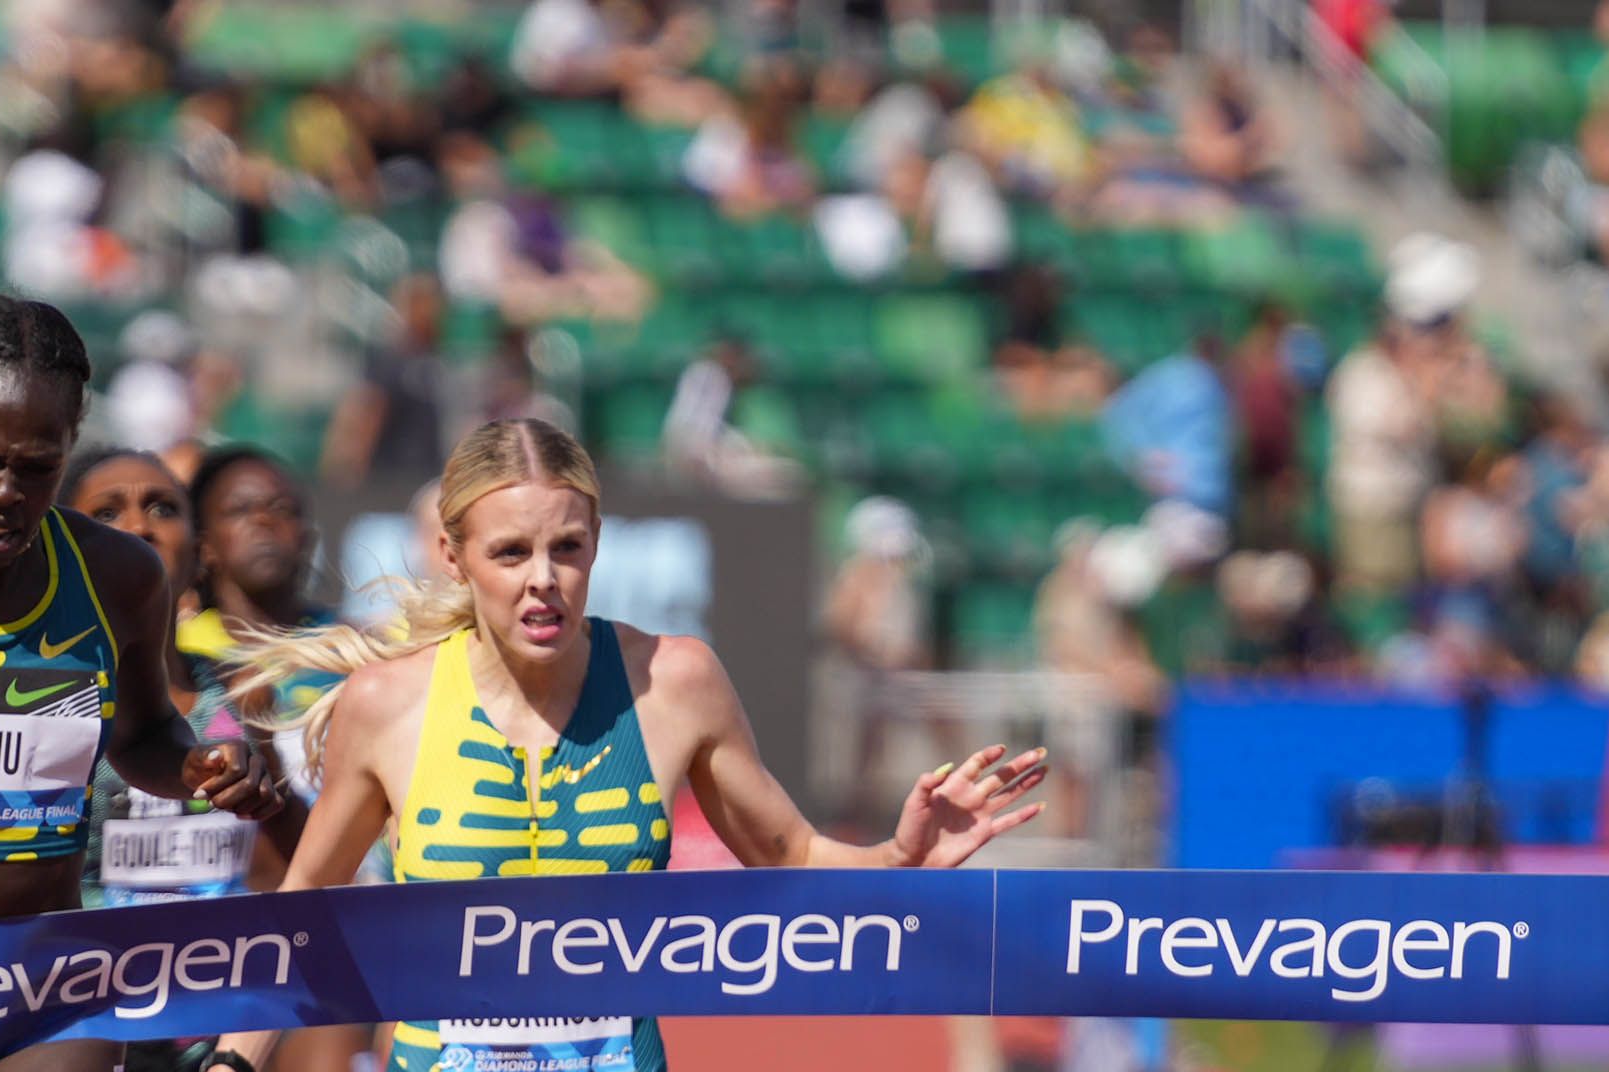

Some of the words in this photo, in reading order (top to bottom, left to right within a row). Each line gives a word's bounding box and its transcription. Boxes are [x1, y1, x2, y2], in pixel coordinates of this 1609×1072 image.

[46, 805, 77, 818] FINAL
[474, 1060, 537, 1072] DIAMOND
[539, 1056, 590, 1071] LEAGUE
